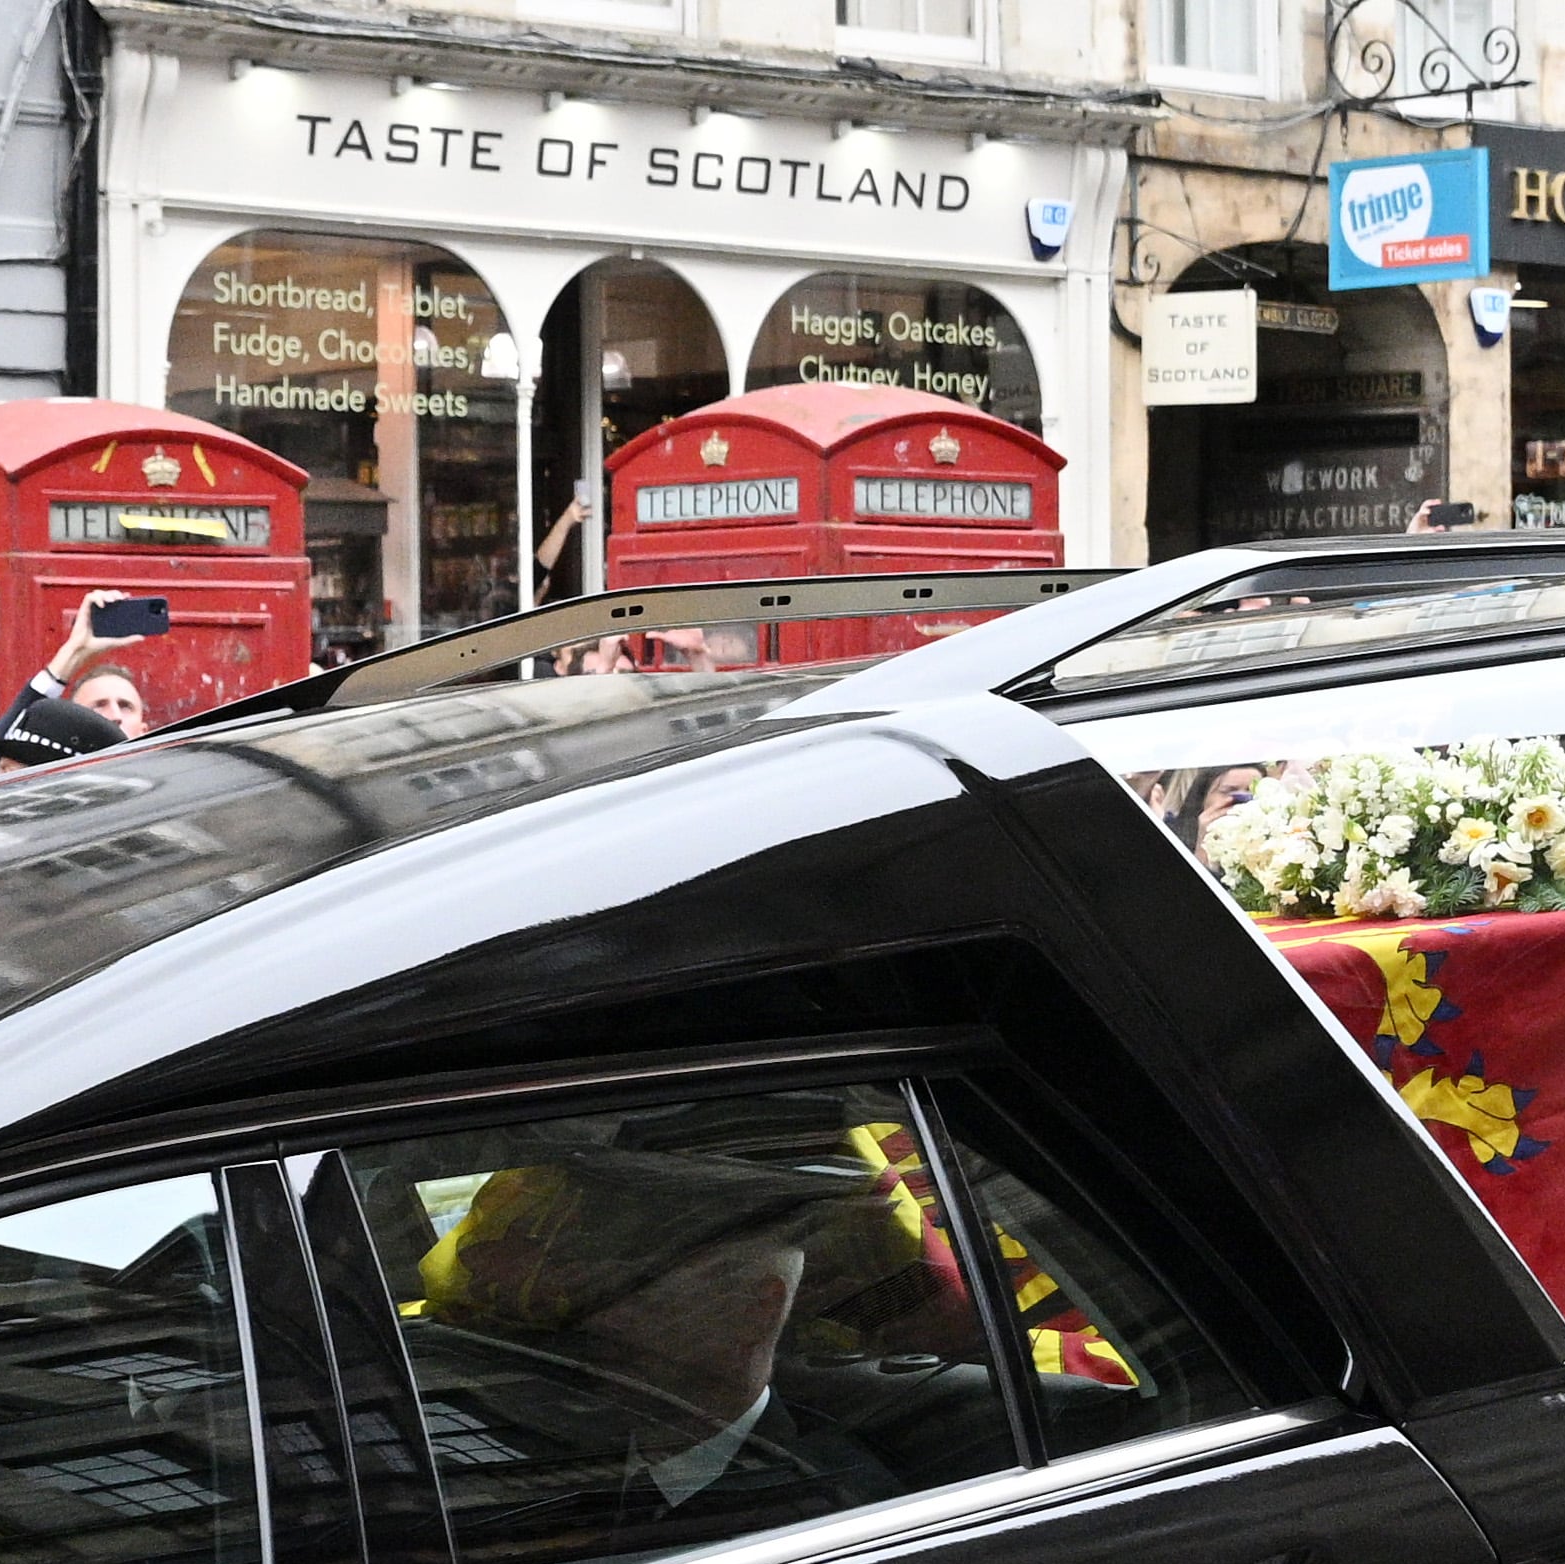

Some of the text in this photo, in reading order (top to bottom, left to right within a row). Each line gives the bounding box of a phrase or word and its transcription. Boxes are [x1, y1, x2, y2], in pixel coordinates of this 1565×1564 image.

[297, 114, 971, 211] TASTE OF SCOTLAND
[1347, 182, 1424, 233] fringe
[1385, 240, 1464, 262] Ticket sales
[212, 271, 475, 326] Shortbread, Tablet,
[791, 304, 1003, 352] Haggis, Oatcakes,
[1168, 314, 1228, 329] TASTE
[212, 321, 476, 375] Fudge, Chocolates,
[1186, 342, 1210, 356] OF
[913, 361, 996, 402] Honey,
[1147, 366, 1250, 384] SCOTLAND
[214, 374, 469, 419] Handmade Sweets
[645, 480, 794, 520] TELEPHONE
[860, 480, 1024, 517] TELEPHONE
[1266, 466, 1380, 494] WEWORK
